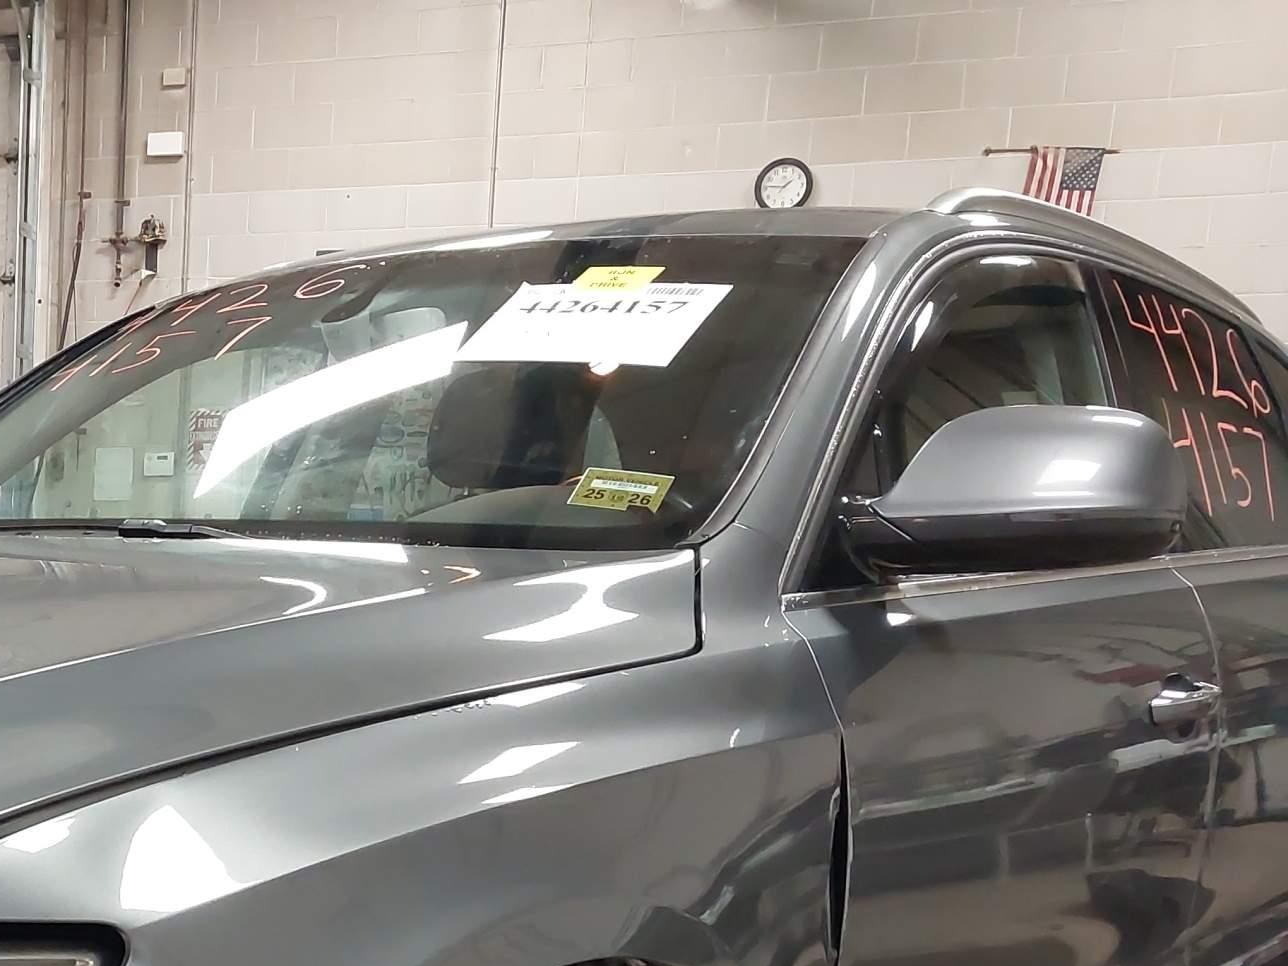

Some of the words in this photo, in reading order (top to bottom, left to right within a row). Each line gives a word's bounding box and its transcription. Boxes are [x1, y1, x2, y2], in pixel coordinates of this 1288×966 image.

[520, 300, 689, 314] 44264157
[1113, 279, 1271, 418] 4426
[198, 418, 219, 428] FIRE
[1162, 397, 1274, 522] 4157
[583, 489, 607, 500] 25
[628, 493, 652, 505] 26
